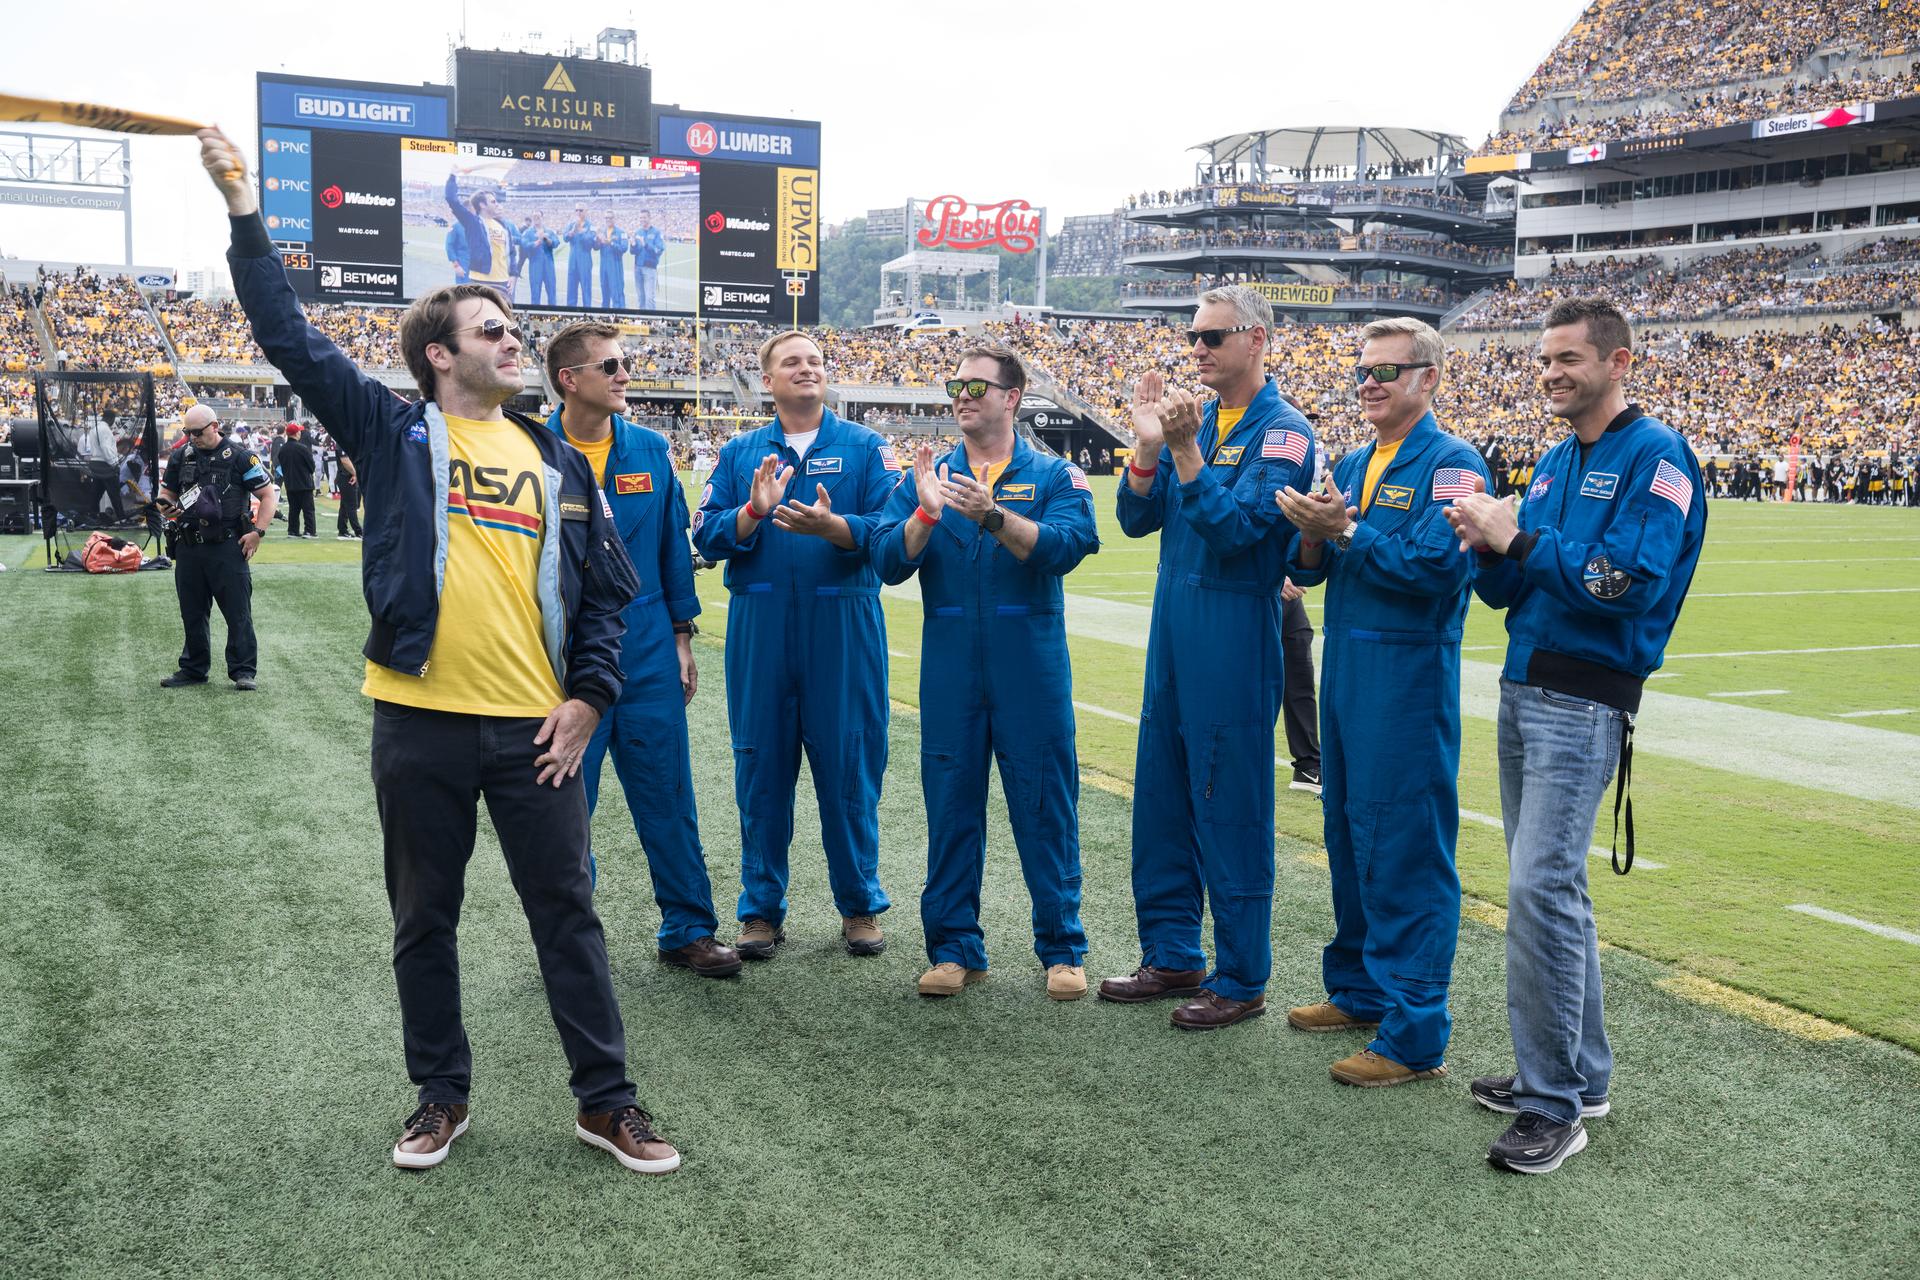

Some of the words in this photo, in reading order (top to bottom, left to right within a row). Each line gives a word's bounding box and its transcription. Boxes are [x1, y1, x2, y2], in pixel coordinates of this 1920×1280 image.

[299, 98, 345, 117] BUD
[348, 102, 411, 122] LIGHT
[500, 94, 616, 118] ACRISURE
[524, 115, 593, 131] STADIUM
[1768, 118, 1808, 133] Steelers
[280, 141, 310, 154] PNC
[410, 140, 446, 153] Steelers
[690, 128, 713, 149] 84
[720, 131, 792, 155] LUMBER
[462, 145, 473, 154] 13
[483, 146, 500, 156] 3RD
[523, 151, 533, 159] ON
[534, 151, 546, 160] 49
[562, 153, 582, 163] 2ND
[584, 155, 604, 165] 1:56
[638, 159, 643, 167] 7
[655, 163, 697, 173] FALCONS
[281, 180, 310, 192] PNC
[26, 193, 68, 205] Utilities
[70, 196, 121, 209] Company
[344, 191, 396, 207] Wabtec
[281, 217, 311, 230] PNC
[725, 218, 771, 232] Wabtec
[791, 176, 813, 265] UPMC
[338, 226, 380, 236] WABTEC.COM
[284, 254, 308, 268] 1:56
[343, 271, 398, 286] BETMGM
[723, 291, 770, 304] BETMGM
[449, 458, 543, 515] ASA
